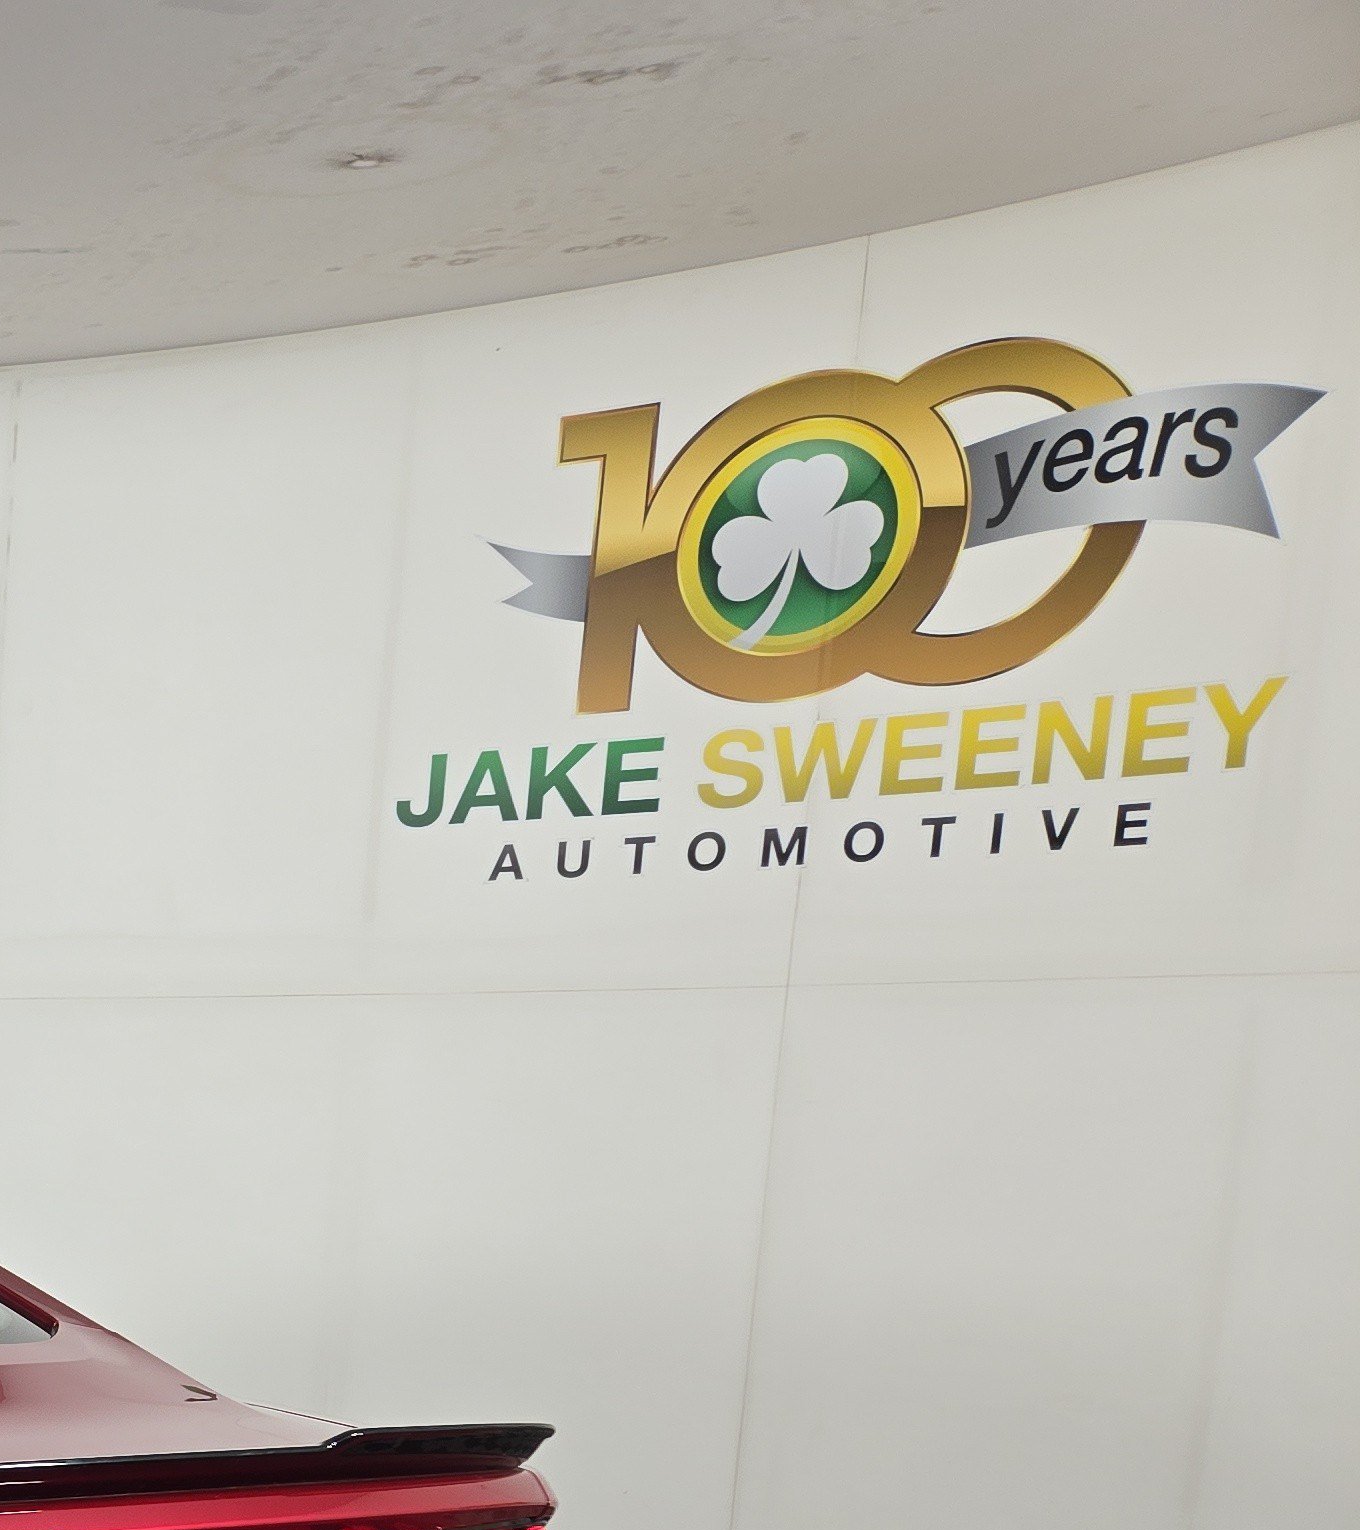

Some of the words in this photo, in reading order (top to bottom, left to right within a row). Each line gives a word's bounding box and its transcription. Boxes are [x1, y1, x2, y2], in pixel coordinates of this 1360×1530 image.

[559, 337, 1145, 715] 100
[986, 405, 1239, 529] years
[397, 737, 665, 827] JAKE
[698, 676, 1288, 808] SWEENEY
[489, 802, 1152, 882] AUTOMOTIVE
